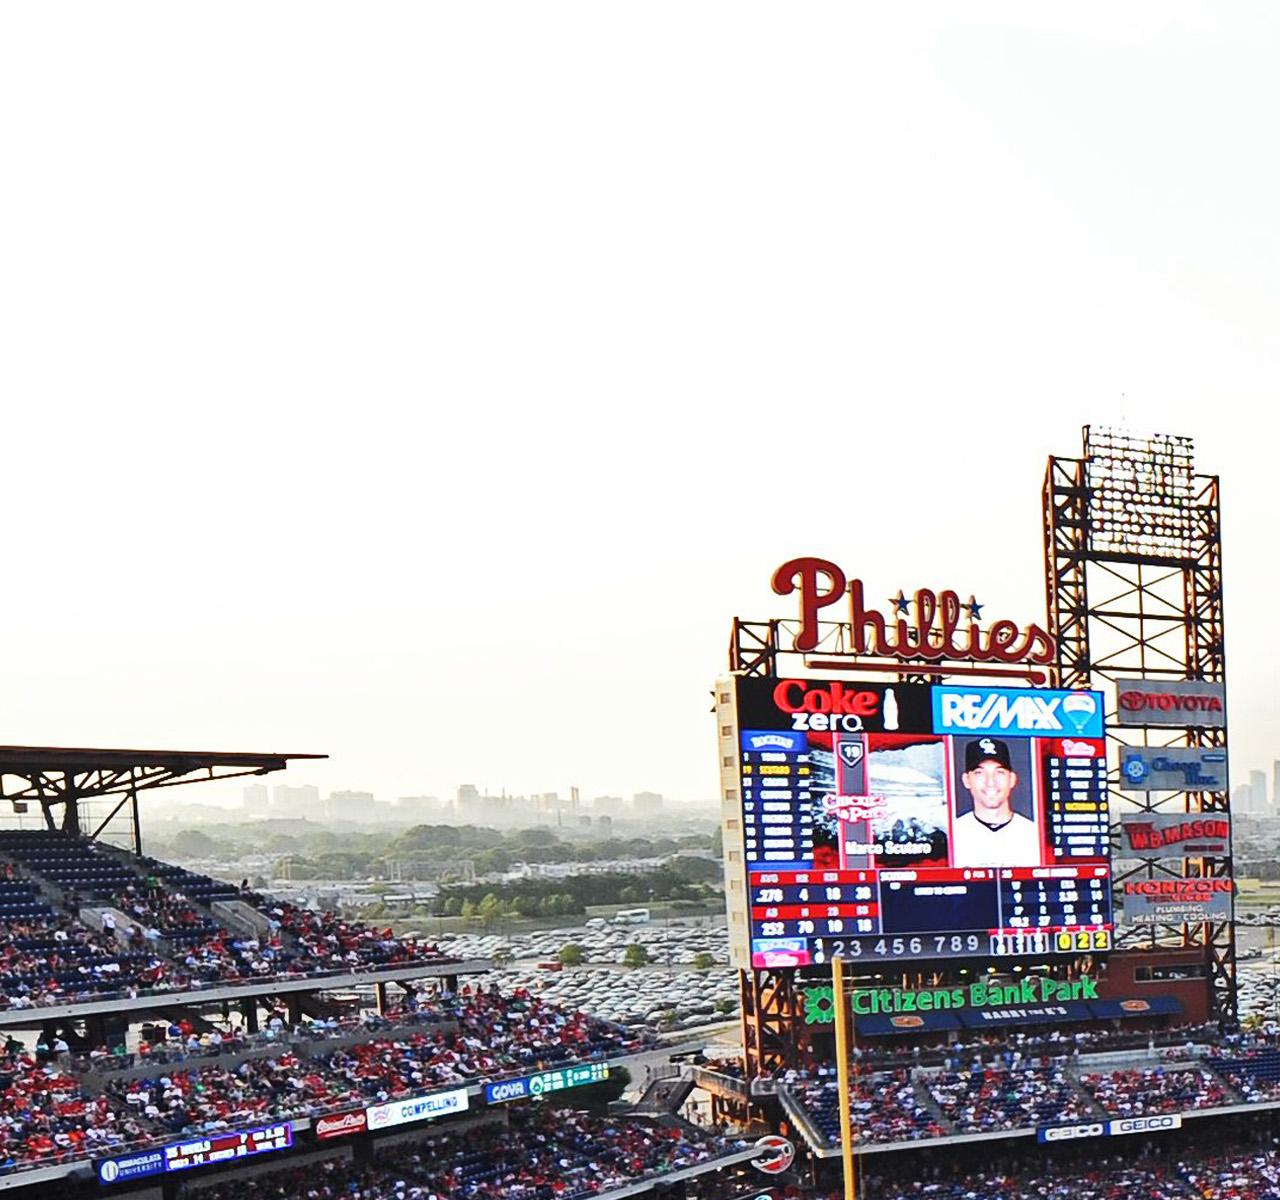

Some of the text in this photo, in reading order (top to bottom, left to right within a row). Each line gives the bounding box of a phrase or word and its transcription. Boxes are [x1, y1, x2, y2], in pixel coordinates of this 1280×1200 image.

[771, 557, 1056, 666] Phillies
[773, 679, 879, 715] Coke
[1148, 692, 1222, 713] TOYOTA
[792, 712, 864, 732] zero
[941, 693, 1063, 730] RE/MAX
[1123, 881, 1233, 895] HORIZON
[833, 941, 845, 956] 2
[850, 940, 862, 956] 3
[875, 939, 887, 954] 4
[893, 938, 904, 954] 5
[910, 937, 922, 954] 6
[934, 936, 946, 952] 7
[951, 935, 963, 951] 8
[967, 935, 979, 950] 9
[1059, 934, 1071, 948] 0
[1077, 933, 1089, 947] 2
[1095, 932, 1106, 947] 2
[852, 975, 1099, 1016] Citizens Bank Park
[401, 1096, 458, 1118] COMPELLING
[1045, 1115, 1173, 1141] GEICO GEICO
